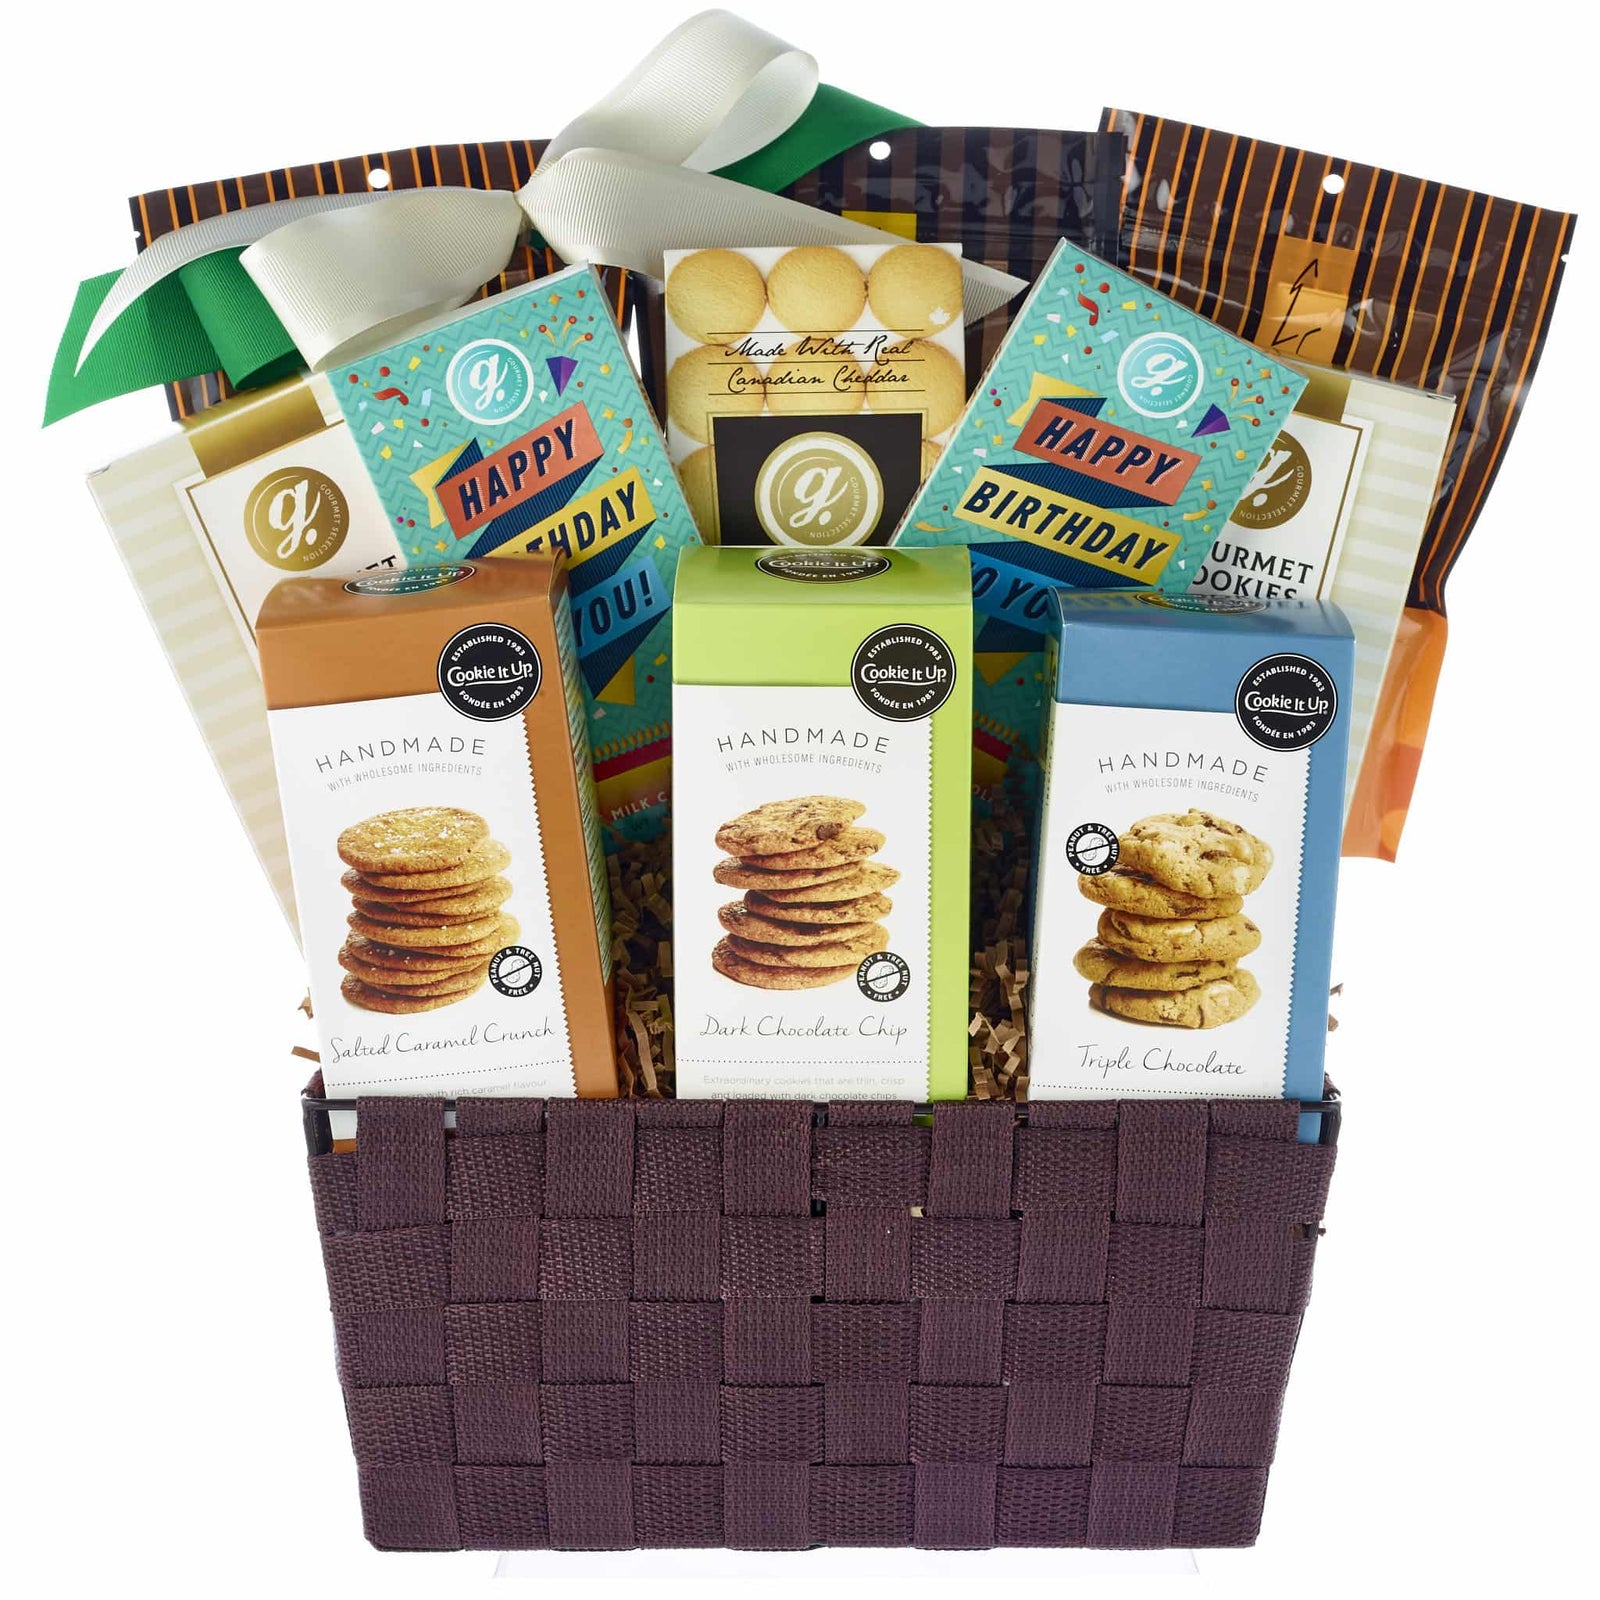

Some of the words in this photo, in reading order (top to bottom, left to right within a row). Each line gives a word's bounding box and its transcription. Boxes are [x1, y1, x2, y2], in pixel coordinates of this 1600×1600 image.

[724, 337, 787, 357] Made
[795, 335, 867, 356] With
[863, 334, 914, 366] Real
[727, 366, 825, 394] Canadian
[832, 365, 910, 392] Cheddar
[1033, 415, 1185, 487] HAPPY
[458, 417, 576, 522] HAPPY
[850, 476, 860, 519] GOURMET
[1287, 465, 1304, 508] GOURMET
[319, 483, 341, 525] GOURMET
[1238, 504, 1287, 521] SELECTION
[962, 480, 1170, 571] BIRTHDAY
[302, 526, 340, 563] SELECTION
[1211, 541, 1314, 585] URMET
[451, 635, 504, 662] ESTABLISHED
[506, 639, 526, 656] 1983
[867, 635, 923, 659] ESTABLISHED
[924, 642, 942, 661] 1983
[447, 664, 496, 687] Cookie
[498, 666, 510, 678] It
[510, 660, 533, 678] Up
[860, 663, 909, 684] Cookie
[912, 667, 923, 680] It
[925, 665, 947, 682] Up
[1252, 665, 1307, 687] ESTABLISHED
[1308, 673, 1325, 692] 1983
[459, 690, 491, 709] FONDÉE
[493, 700, 505, 708] EN
[506, 685, 524, 703] 1983
[870, 687, 900, 709] FONDÉE
[916, 689, 936, 706] 1983
[1244, 691, 1291, 712] Cookie
[1294, 698, 1305, 711] It
[1307, 696, 1329, 714] Up
[1252, 715, 1281, 738] FONDÉE
[1296, 720, 1316, 736] 1983
[315, 736, 486, 773] HANDMADE
[717, 728, 890, 754] HANDMADE
[327, 776, 352, 792] WITH
[354, 763, 413, 783] WHOLESOME
[417, 762, 482, 776] INGREDIENTS
[725, 758, 751, 773] WITH
[753, 753, 814, 767] WHOLESOME
[818, 753, 883, 774] INGREDIENTS
[1098, 751, 1269, 783] HANDMADE
[1104, 781, 1130, 795] WITH
[1132, 776, 1193, 788] WHOLESOME
[1197, 778, 1260, 803] INGREDIENTS
[610, 797, 650, 821] MILK
[1067, 827, 1084, 858] PEANUT
[1097, 825, 1116, 841] TREE
[1110, 843, 1118, 861] NUT
[1080, 865, 1101, 874] FREE
[490, 952, 504, 984] PEANUT
[515, 947, 535, 961] TREE
[531, 961, 541, 979] NUT
[858, 956, 874, 987] PEANUT
[886, 953, 905, 969] TREE
[901, 969, 909, 987] NUT
[507, 986, 529, 996] FREE
[873, 993, 894, 1001] FREE
[330, 1036, 391, 1064] Salted
[395, 1024, 479, 1053] Caramel
[483, 1017, 557, 1044] Crunch
[699, 1014, 751, 1037] Dark
[756, 1015, 851, 1038] Chocolate
[858, 1015, 908, 1046] Chip
[1077, 1043, 1137, 1079] Triple
[1142, 1047, 1247, 1076] Chocolate
[450, 1087, 470, 1098] rich
[513, 1079, 547, 1089] flavour
[710, 1091, 730, 1100] and
[732, 1091, 767, 1100] loaded
[769, 1091, 791, 1100] with
[818, 1091, 868, 1100] chocolate
